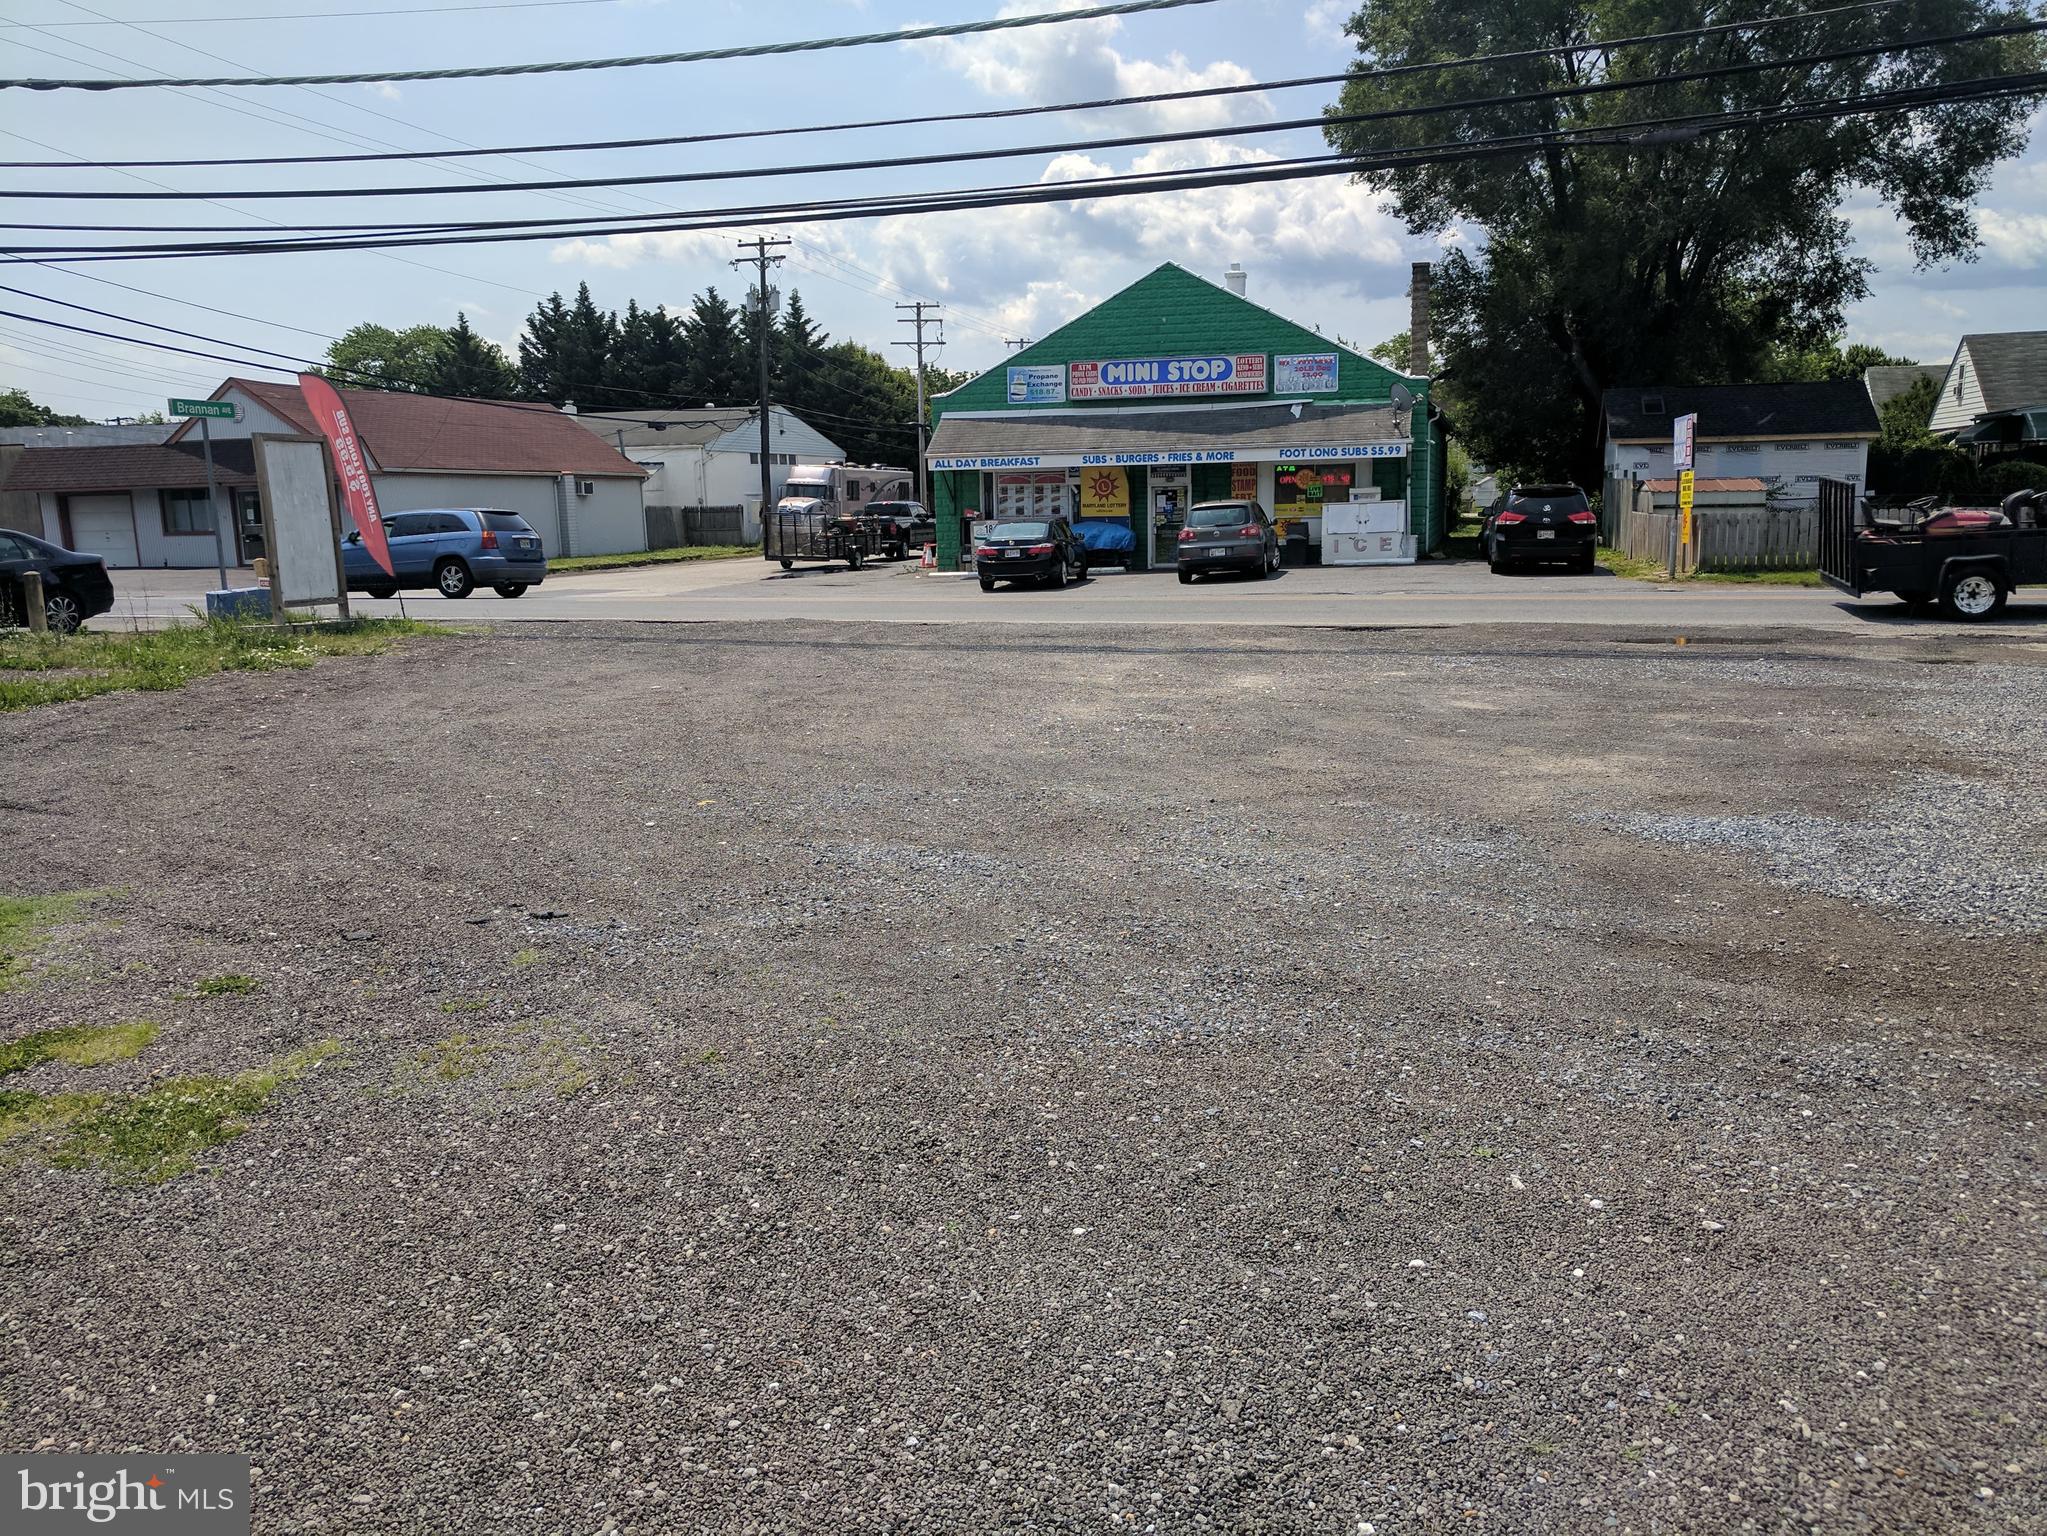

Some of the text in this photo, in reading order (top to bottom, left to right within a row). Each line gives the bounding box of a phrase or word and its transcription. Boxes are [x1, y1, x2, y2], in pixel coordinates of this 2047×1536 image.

[1107, 360, 1226, 382] MINI STOP
[1071, 381, 1264, 397] CANDY SNACKS SODA JUICES ICE CREAM CIGARETTES
[177, 401, 220, 415] Brannan
[1082, 451, 1235, 465] SUBS BURGERS FRIES & MORE
[1279, 445, 1401, 458] FOOT LONG SUBS $5.99
[934, 457, 1041, 469] ALL DAY BREAKFAST
[1333, 537, 1393, 553] ICE
